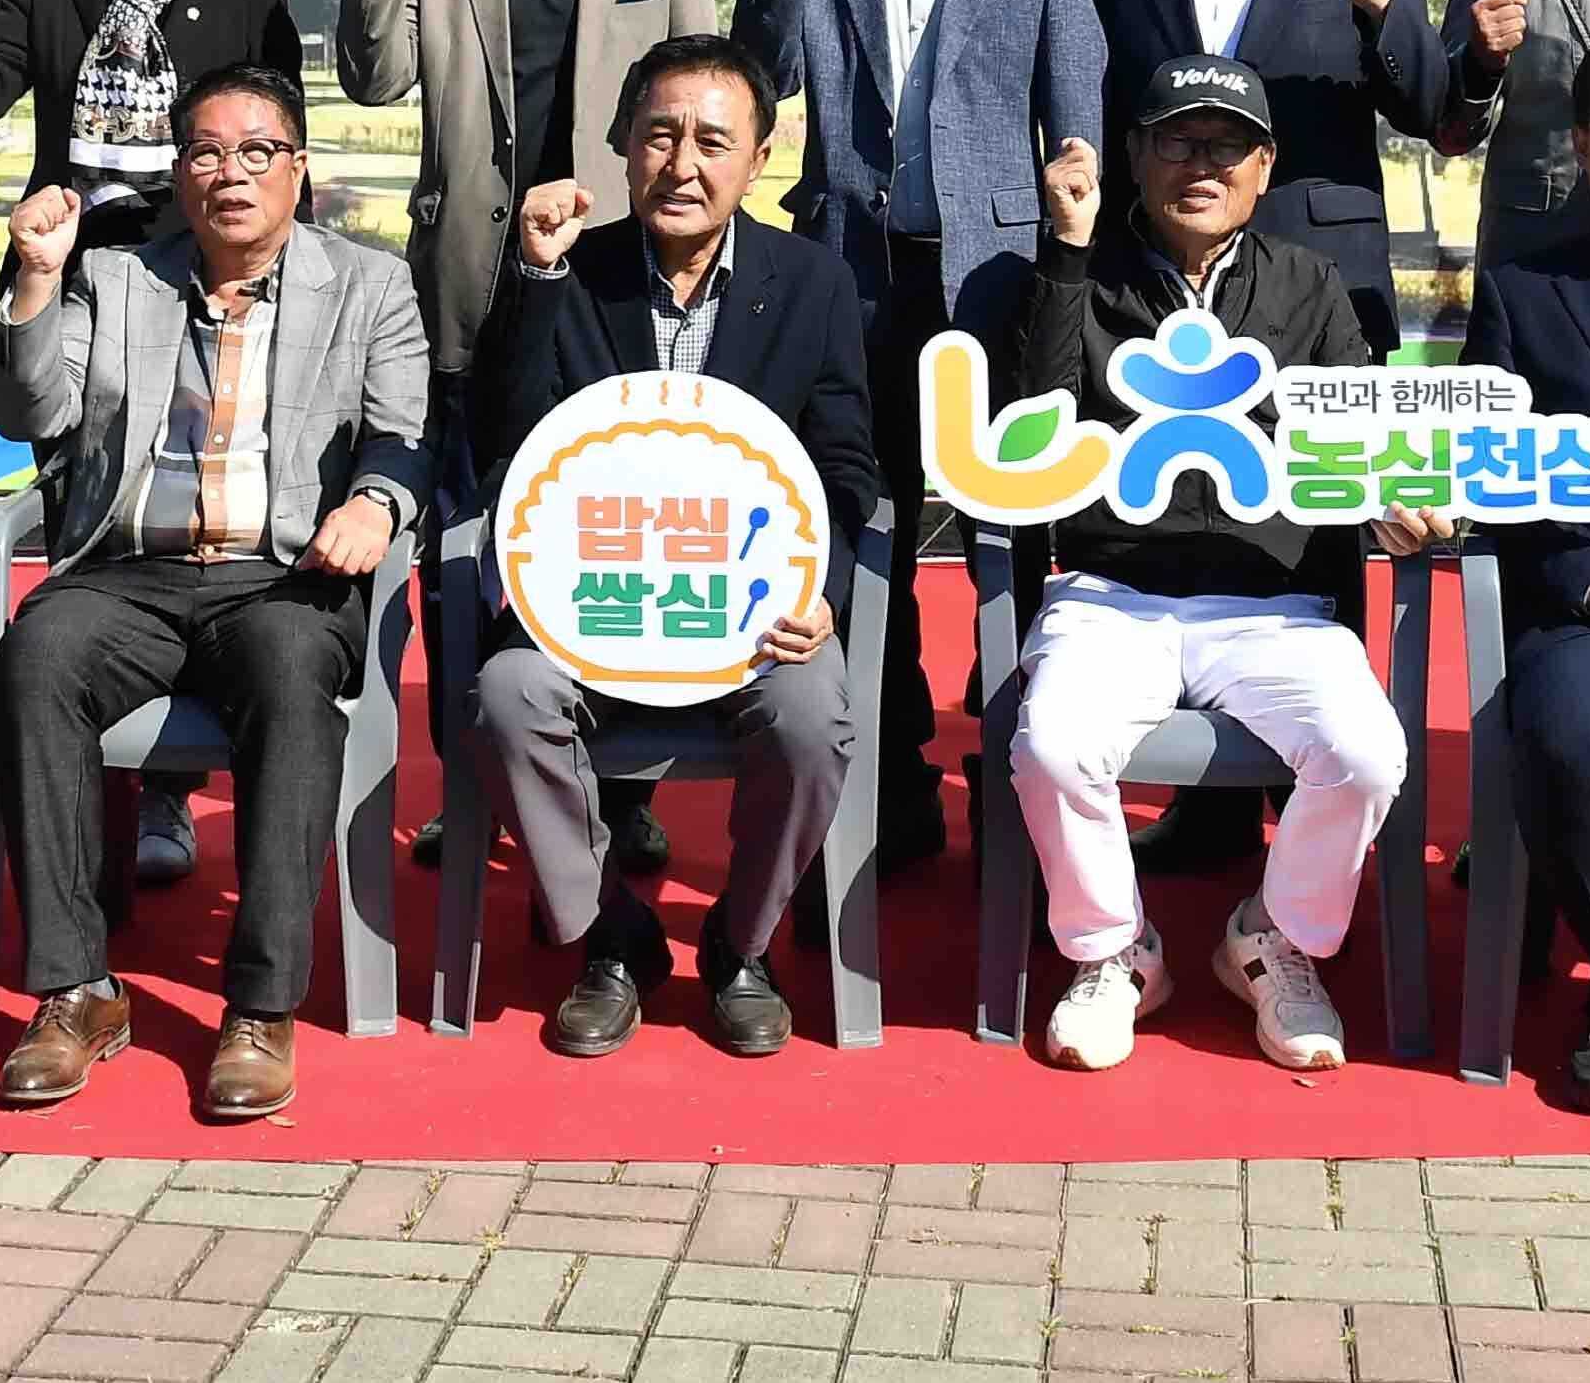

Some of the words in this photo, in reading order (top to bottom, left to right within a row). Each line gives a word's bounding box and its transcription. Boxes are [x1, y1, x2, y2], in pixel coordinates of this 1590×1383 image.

[1170, 66, 1249, 96] Volvik
[1286, 380, 1381, 415] 국민과
[1390, 380, 1517, 415] 함께하는
[577, 496, 729, 563] 밥씸
[572, 572, 728, 639] 쌀심
